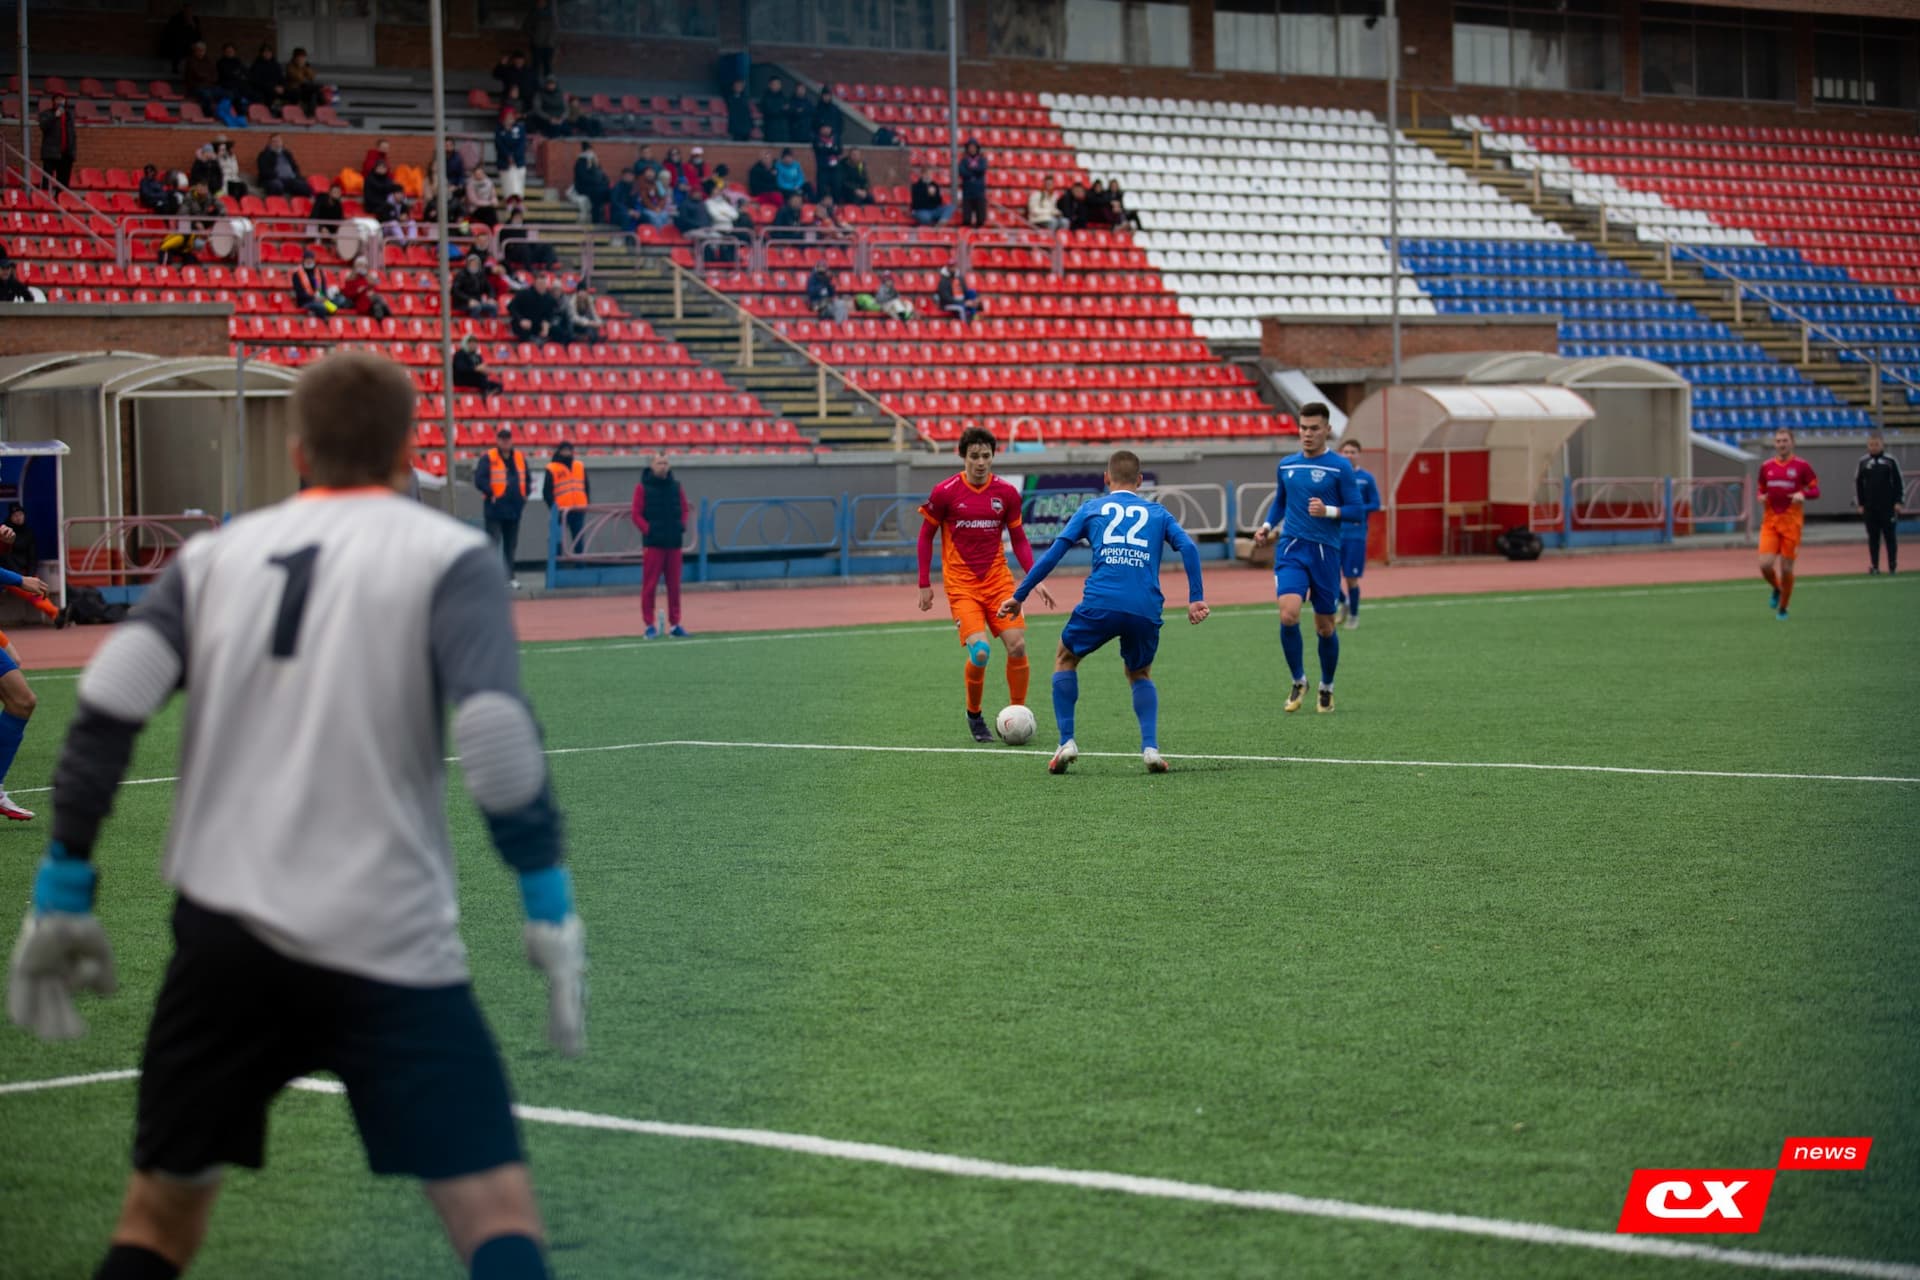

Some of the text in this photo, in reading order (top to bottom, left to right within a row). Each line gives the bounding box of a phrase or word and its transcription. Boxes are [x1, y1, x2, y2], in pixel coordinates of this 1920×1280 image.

[1101, 502, 1149, 547] 22
[1101, 547, 1150, 560] ИРКУТСКАЯ
[1105, 556, 1144, 568] ОБЛАСТЬ
[267, 542, 322, 659] 1
